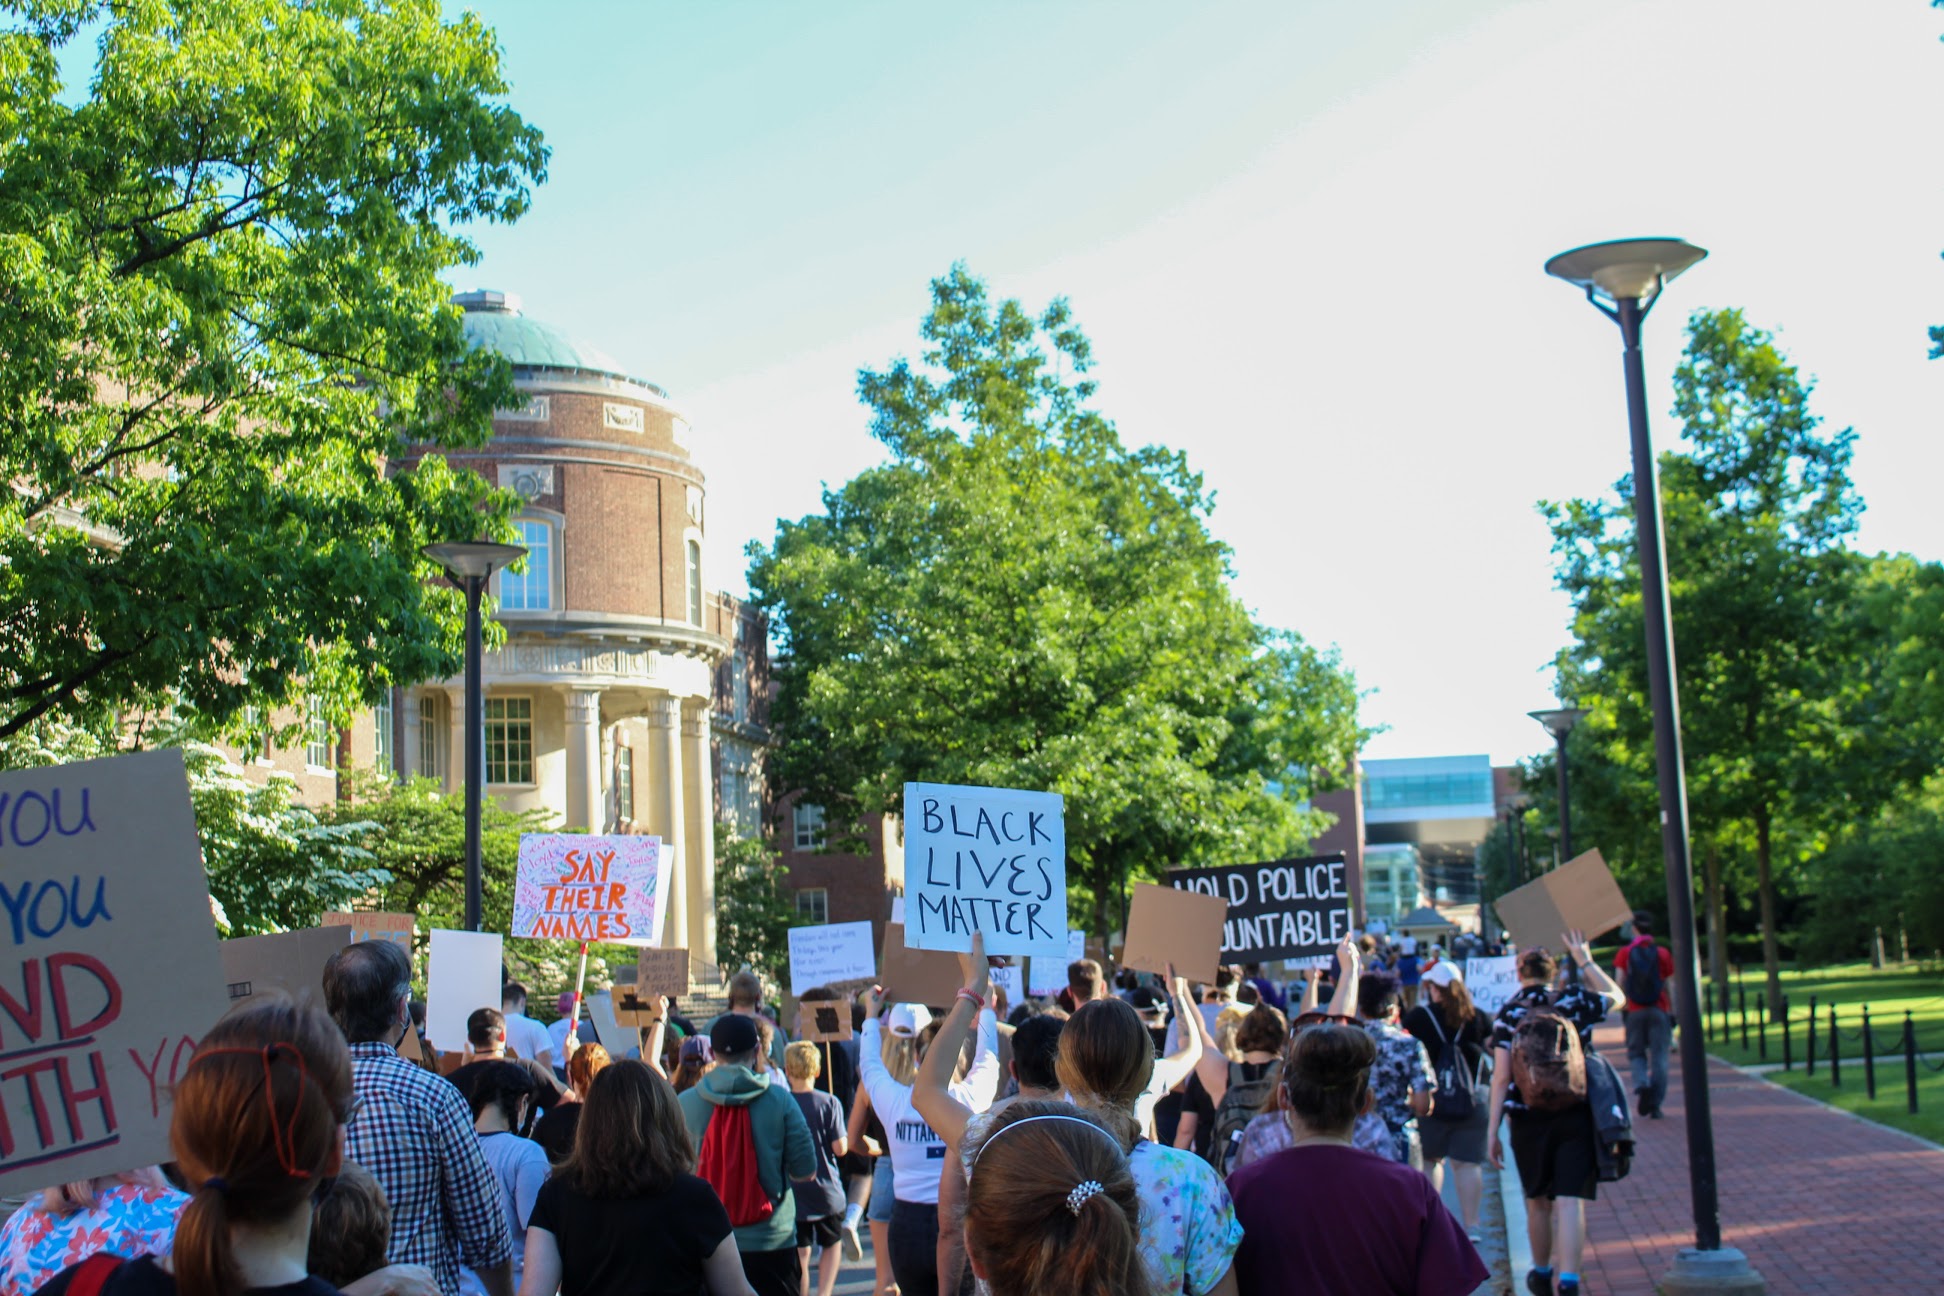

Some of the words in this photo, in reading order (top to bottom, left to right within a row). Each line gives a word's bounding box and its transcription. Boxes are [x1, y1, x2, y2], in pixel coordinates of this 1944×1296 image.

[923, 799, 1051, 845] BLACK
[560, 850, 616, 883] SAY
[927, 847, 1051, 900] LIVES
[1257, 862, 1348, 904] POLICE
[0, 875, 112, 945] YOU
[541, 882, 627, 912] THEIR
[328, 914, 376, 928] JUSTICE
[387, 915, 410, 929] FOR
[532, 912, 631, 939] NAMES
[918, 892, 1053, 940] MATTER
[1470, 959, 1493, 977] NO
[896, 1120, 941, 1142] NITTAN
